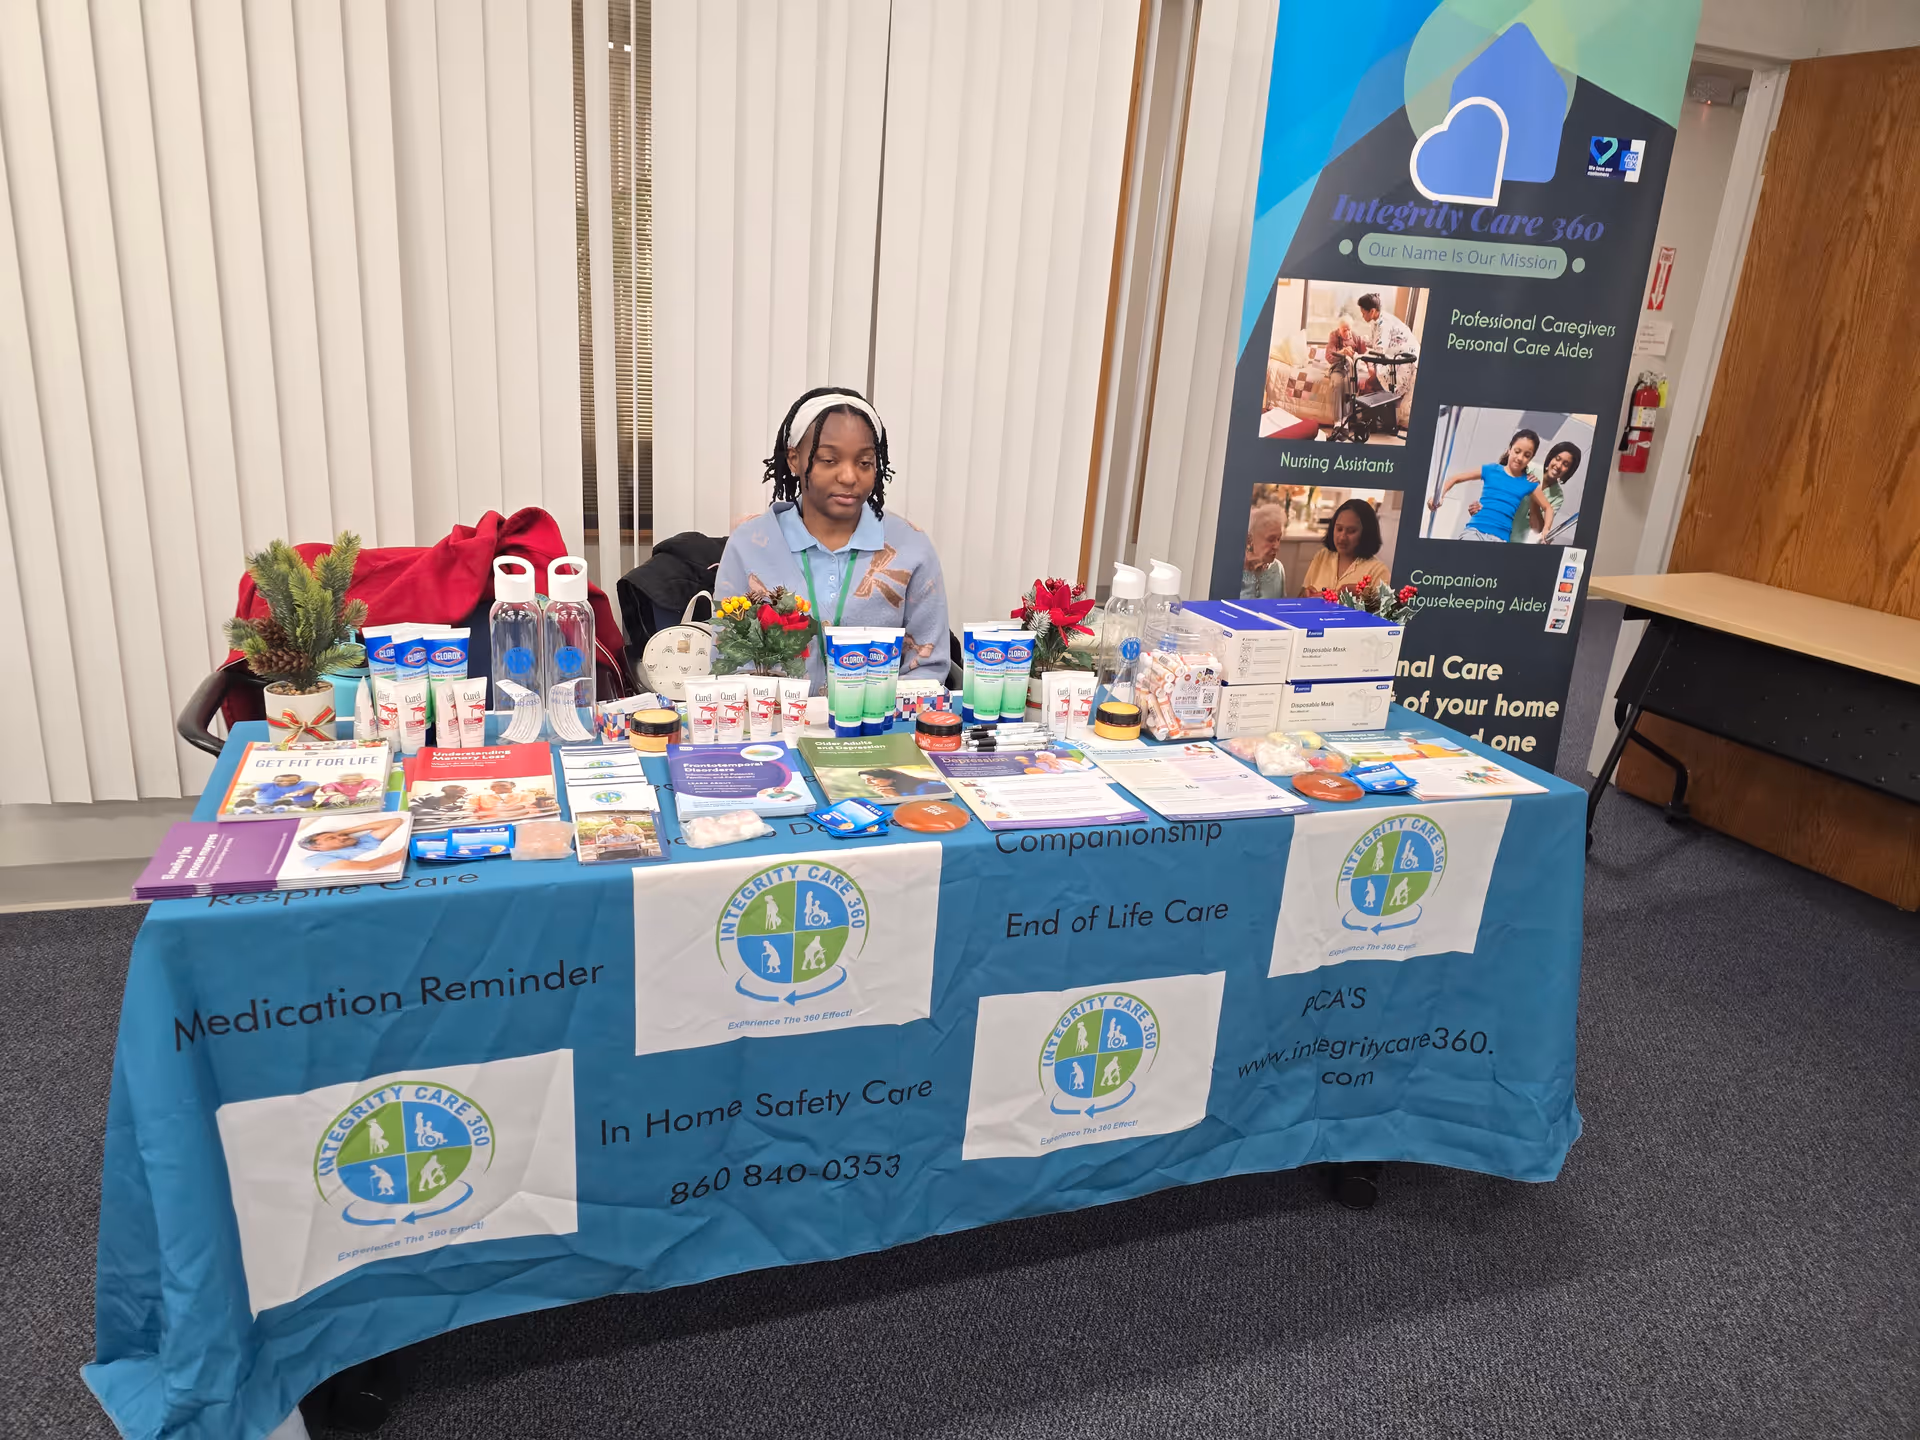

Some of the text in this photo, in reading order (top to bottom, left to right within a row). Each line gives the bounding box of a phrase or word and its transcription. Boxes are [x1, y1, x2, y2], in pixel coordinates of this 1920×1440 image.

[1330, 194, 1605, 243] Integrity Care 360
[1368, 241, 1558, 271] Our Name Is Our Mission
[1451, 308, 1537, 331] Professional
[1541, 315, 1616, 338] Caregivers
[1447, 332, 1594, 359] Personal Care Aides
[1280, 451, 1394, 473] Nursing Assistants
[1410, 569, 1498, 590] Companions
[1407, 594, 1547, 614] Housekeeping Aides
[378, 648, 396, 658] CLOR
[435, 651, 462, 660] CLOROX
[842, 656, 864, 664] CLOROX
[868, 653, 884, 661] OROX
[980, 652, 1002, 660] CLOROX
[1008, 650, 1028, 658] CLOROX
[1442, 655, 1503, 681] Care
[1402, 690, 1430, 714] of
[1434, 698, 1488, 720] your
[1494, 694, 1560, 718] home
[1490, 734, 1537, 752] one
[255, 756, 379, 768] GET FIT FOR LIFE
[940, 756, 1010, 764] Depression
[994, 822, 1222, 856] Companionship
[1340, 818, 1445, 882] INTEGRITY CARE 360
[207, 872, 480, 908] Respite Care
[720, 865, 866, 942] INTEGRITY CARE 360
[1006, 898, 1229, 939] End of Life Care
[172, 960, 605, 1052] Medication Reminder
[728, 1009, 853, 1030] Experience The 360 Effect!
[1042, 996, 1157, 1067] INTEGRITY CARE 360
[1238, 1026, 1494, 1079] www.integritycare360.
[1321, 1070, 1374, 1088] com
[601, 1079, 933, 1146] In Home Safety Care
[319, 1086, 490, 1176] INTEGRITY CARE 360
[1040, 1120, 1138, 1146] Experience The 360 Effect!
[670, 1153, 902, 1206] 860 840-0353
[337, 1238, 400, 1262] Experience
[404, 1234, 424, 1244] The
[427, 1229, 448, 1239] 360
